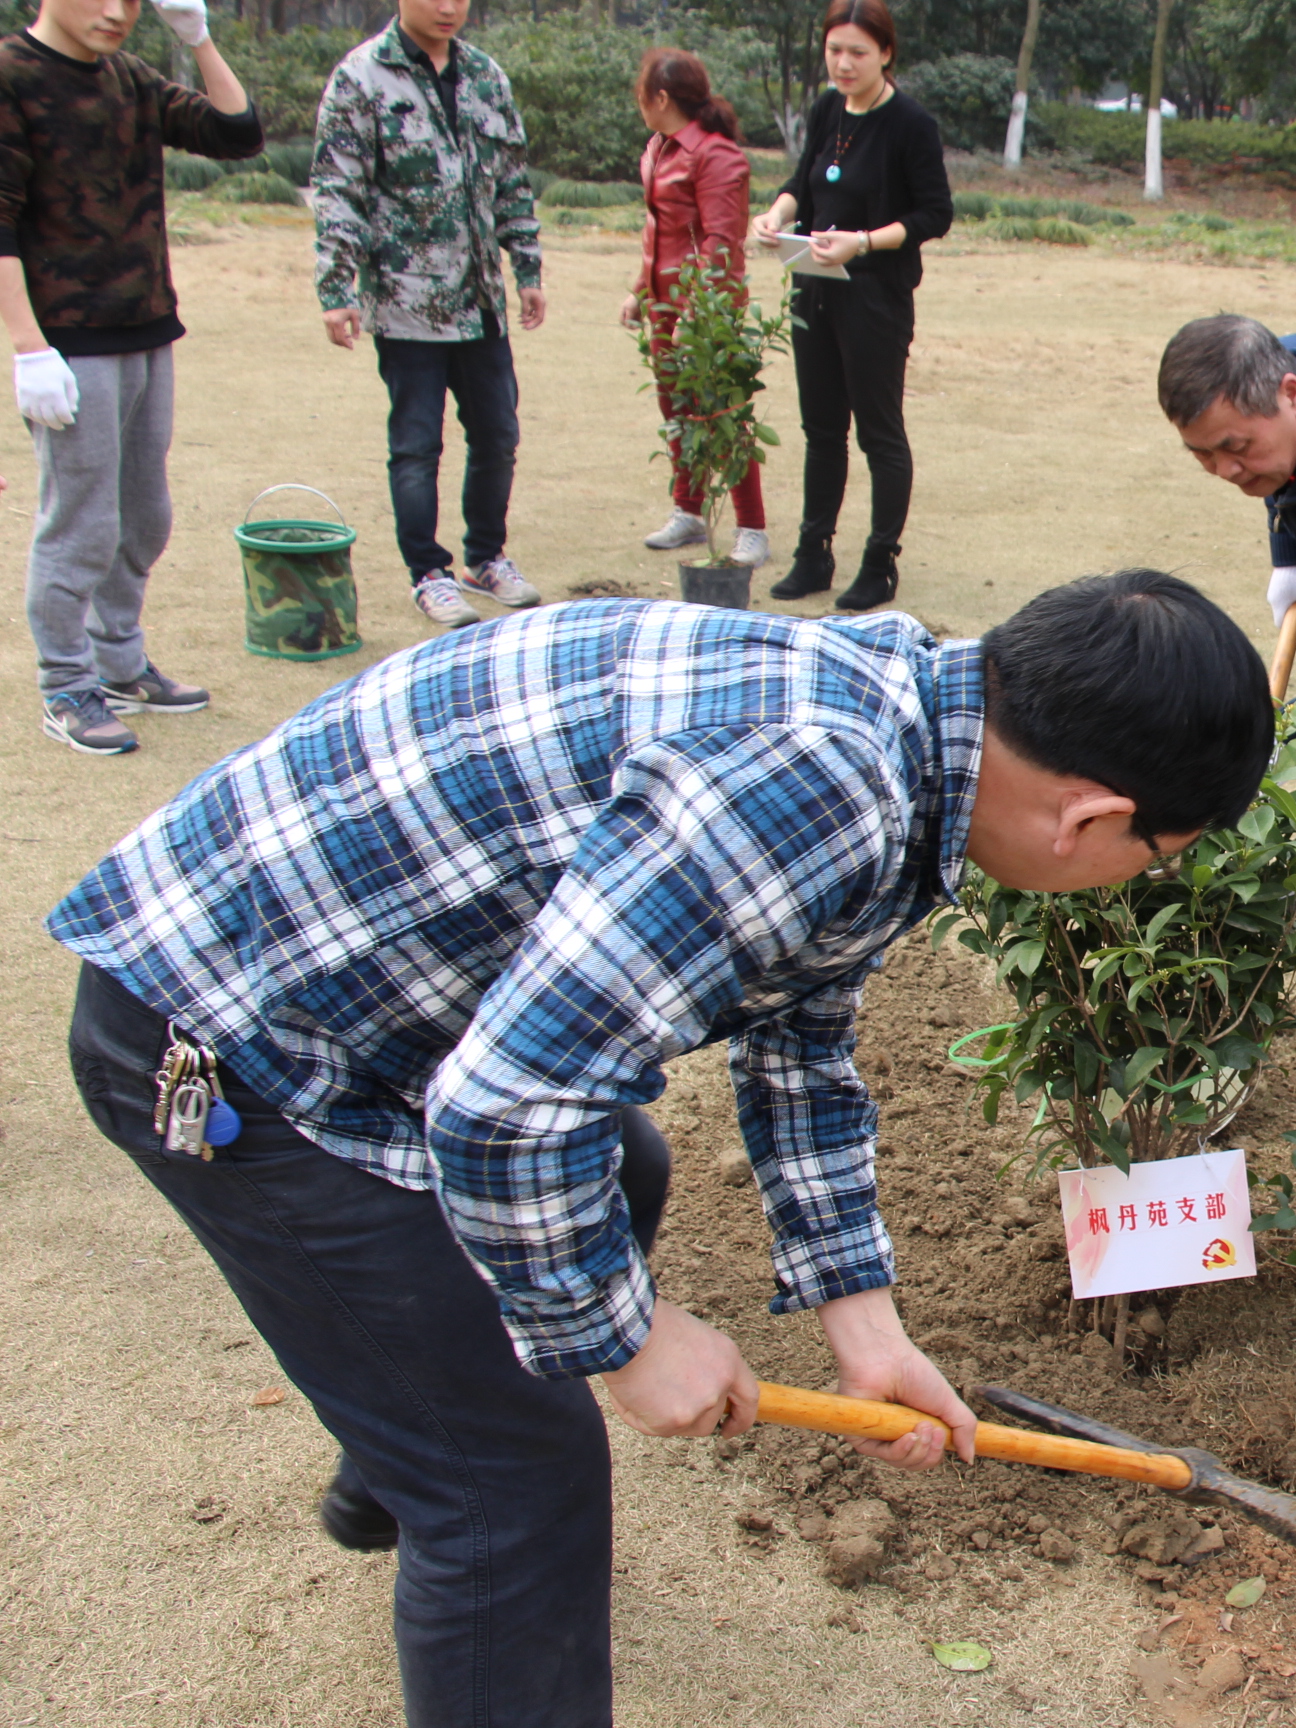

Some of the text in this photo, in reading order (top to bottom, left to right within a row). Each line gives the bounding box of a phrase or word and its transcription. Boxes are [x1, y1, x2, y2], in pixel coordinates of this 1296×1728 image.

[1088, 1193, 1226, 1235] 枫丹苑支部
